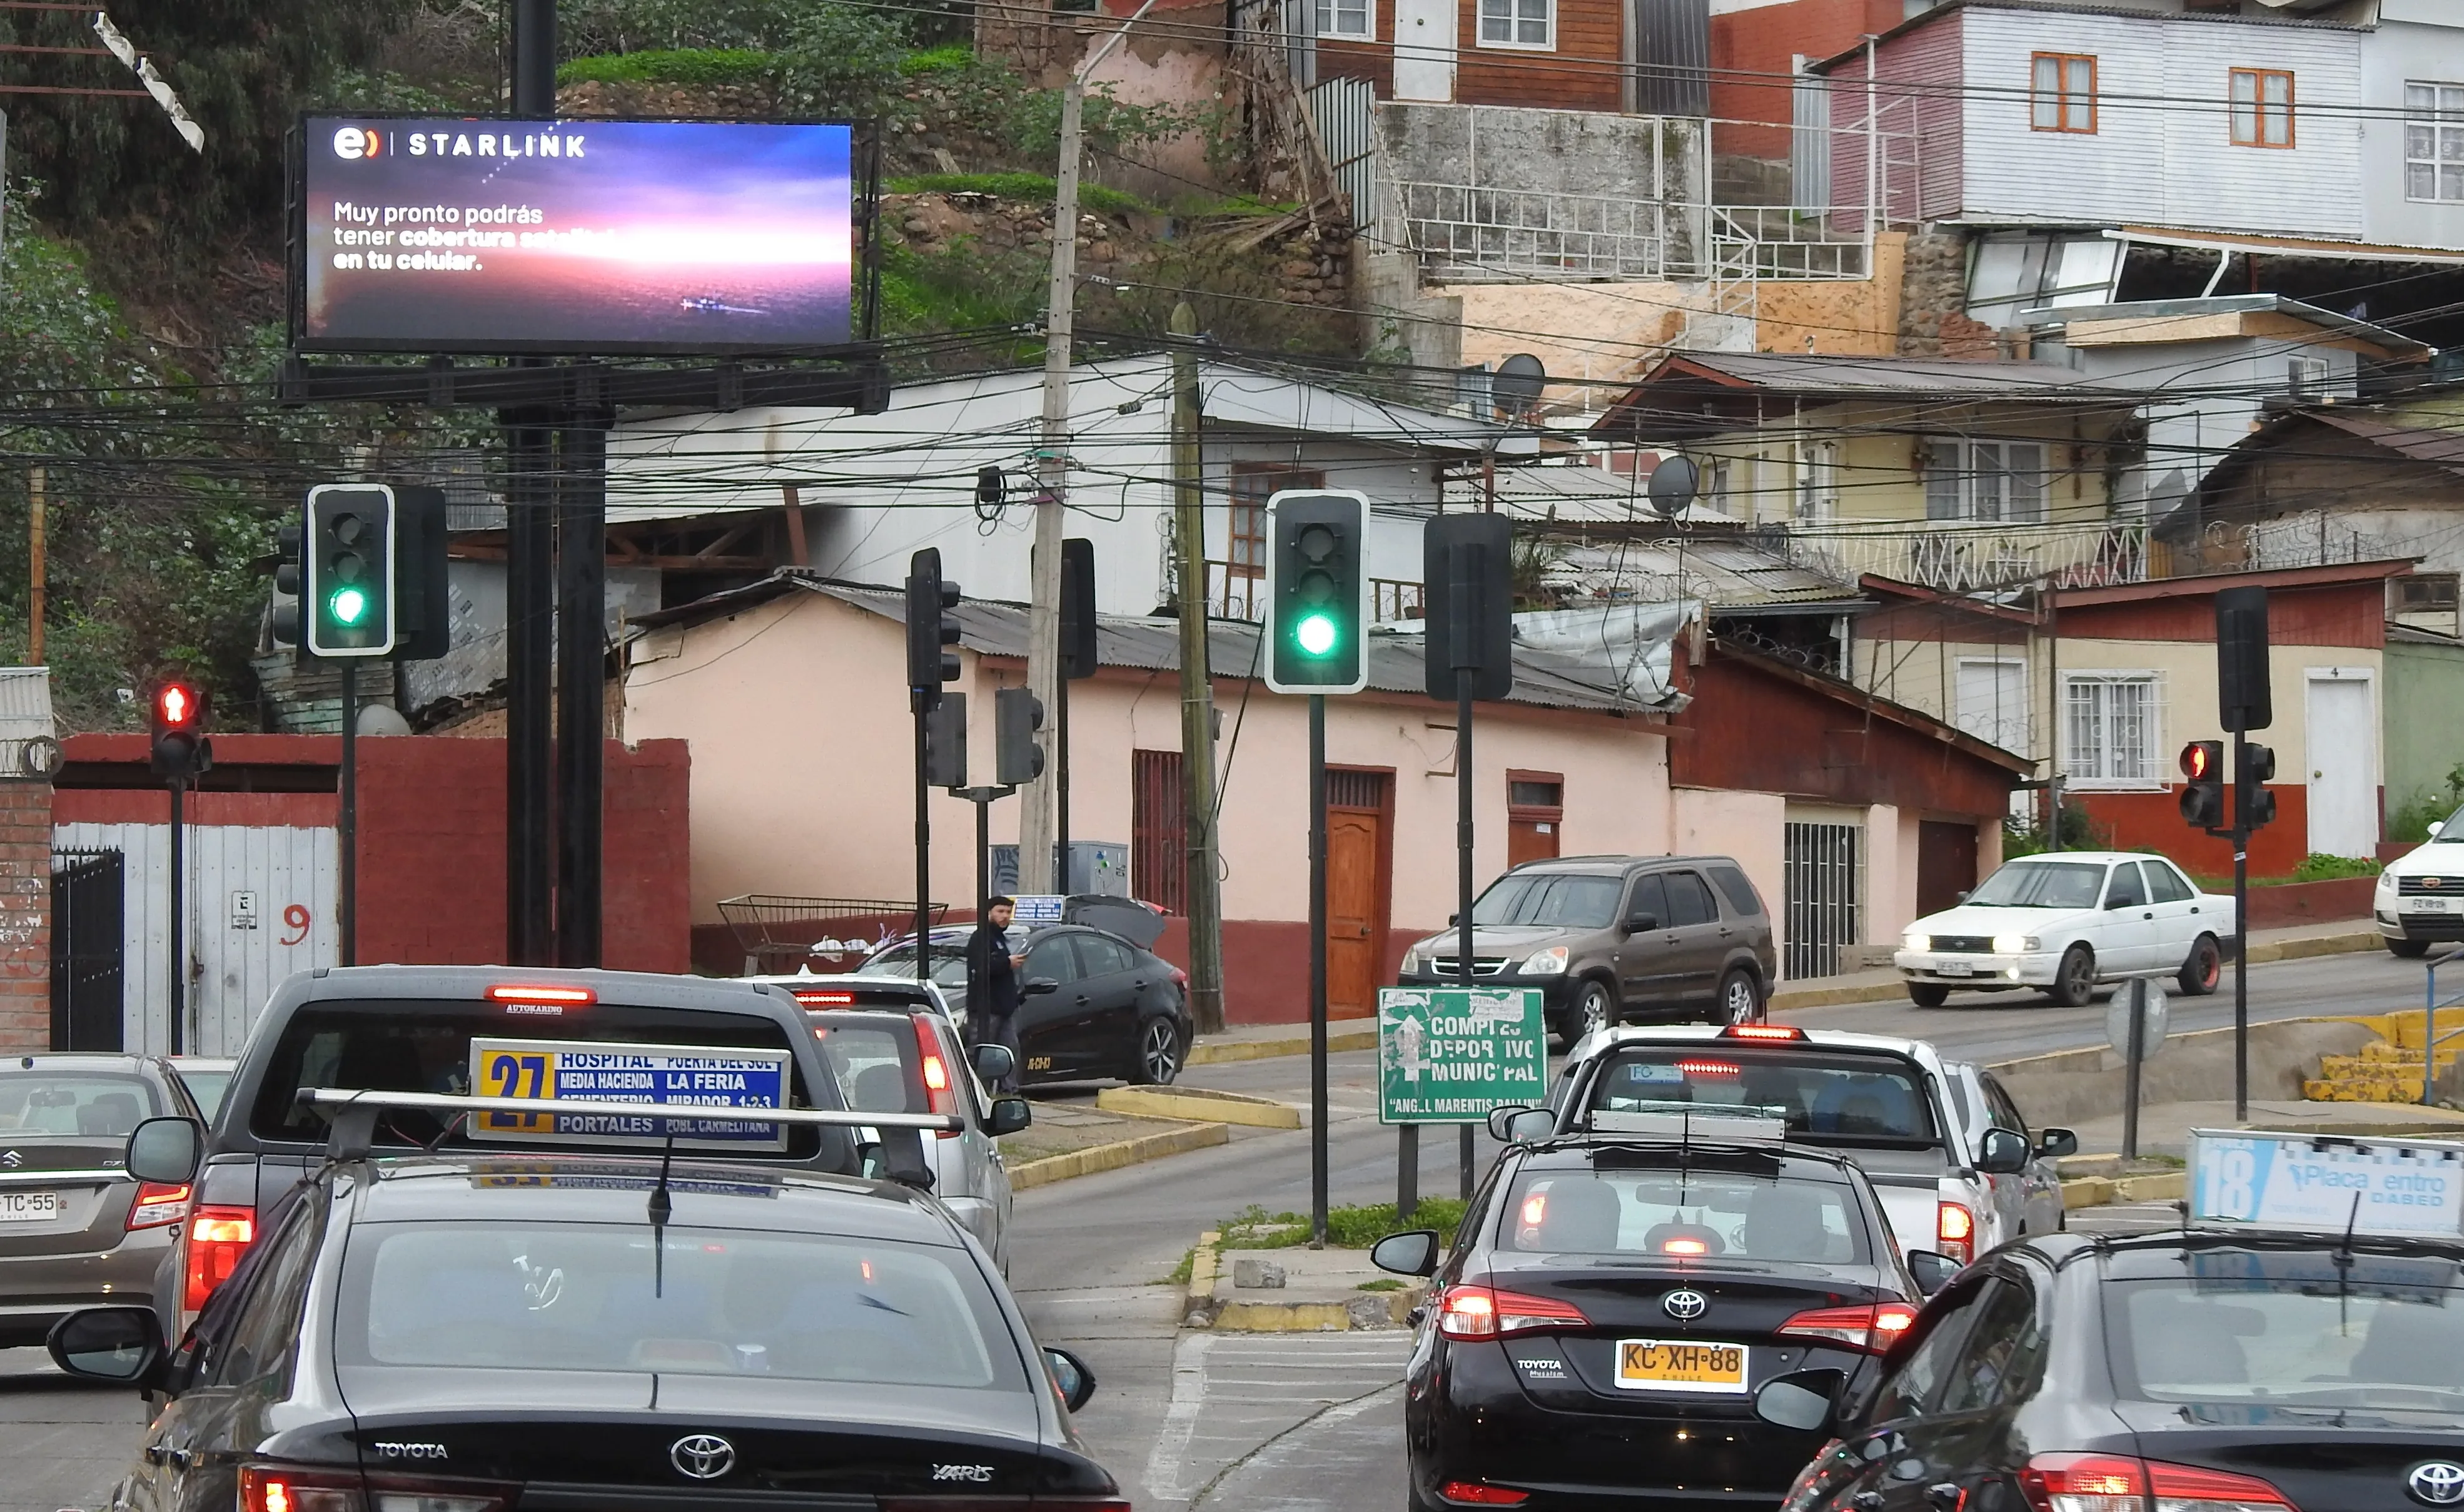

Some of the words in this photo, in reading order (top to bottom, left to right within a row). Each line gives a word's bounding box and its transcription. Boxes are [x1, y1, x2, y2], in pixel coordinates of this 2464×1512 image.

[409, 133, 585, 158] STARLINK
[333, 201, 378, 226] Muy
[384, 205, 460, 226] pronto
[465, 204, 543, 226] podrás
[333, 228, 395, 246] tener
[399, 226, 515, 247] cobertura
[520, 227, 615, 248] sateli
[333, 251, 363, 270] en
[366, 251, 391, 270] tu
[396, 251, 483, 270] celular.
[281, 904, 310, 945] 9
[562, 1053, 654, 1068] HOSPITAL
[560, 1073, 595, 1088] MEDIA
[598, 1073, 654, 1089] HACIENDA
[667, 1073, 689, 1089] LA
[694, 1073, 746, 1090] FERIA
[1431, 1063, 1538, 1082] MUNICPAL
[491, 1055, 545, 1127] 27
[559, 1116, 654, 1132] PORTALES
[2200, 1150, 2256, 1217] 18
[1517, 1360, 1562, 1369] TOYOTA
[375, 1443, 448, 1459] TOYOTA
[932, 1464, 995, 1482] YARIS
